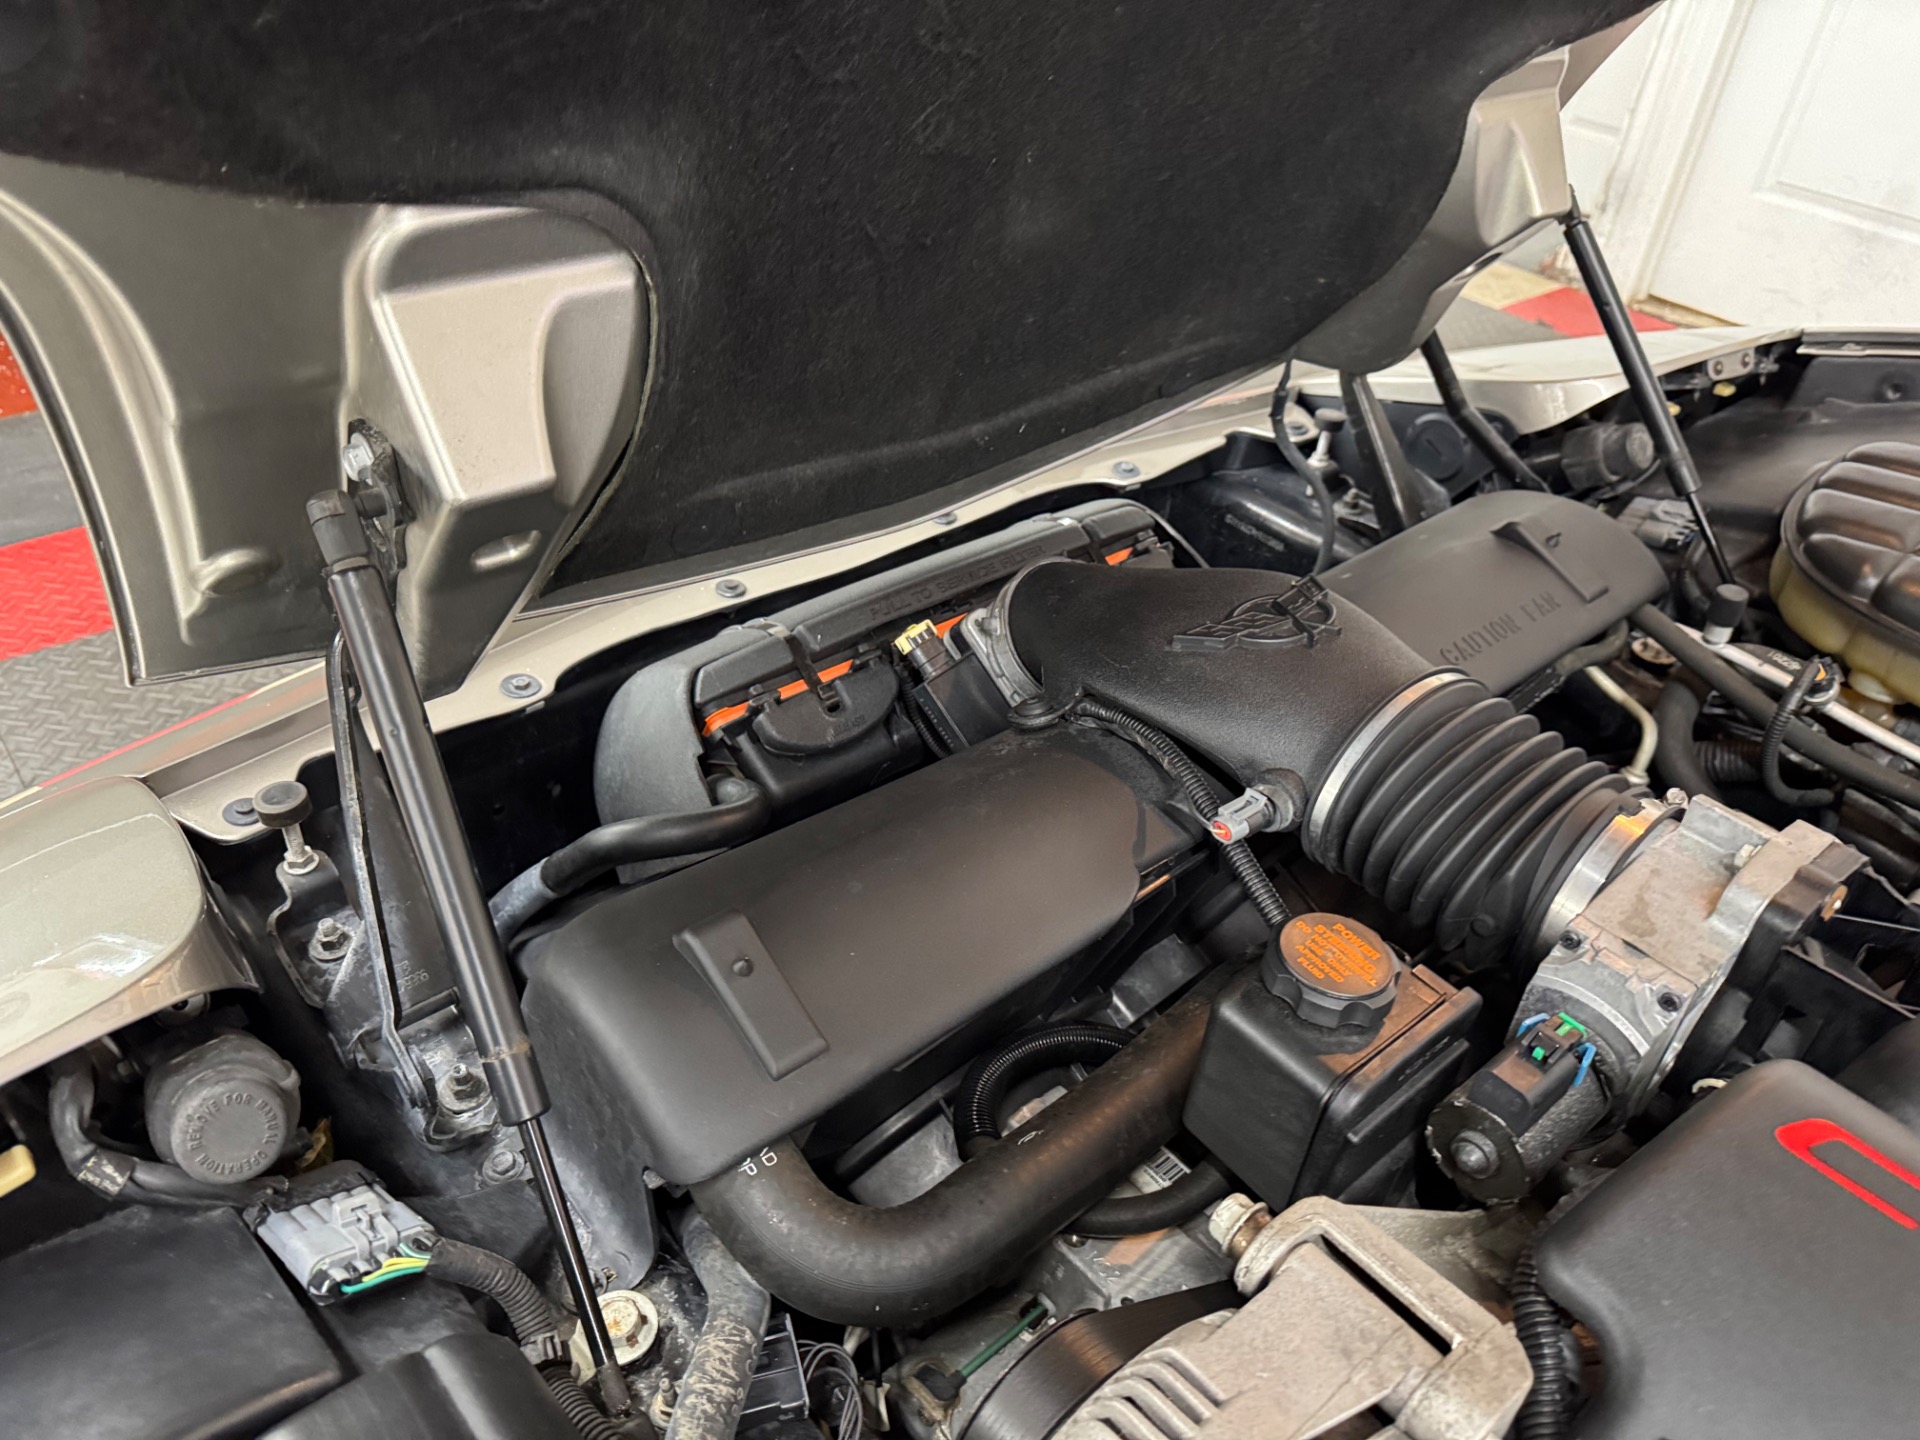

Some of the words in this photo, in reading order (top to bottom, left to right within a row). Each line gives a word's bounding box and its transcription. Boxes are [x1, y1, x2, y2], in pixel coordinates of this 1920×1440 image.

[869, 595, 911, 621] PULL
[911, 586, 932, 602] TO
[935, 562, 1000, 593] SERVICE
[1001, 544, 1046, 570] FILTER
[1439, 613, 1522, 665] CAUTION
[1519, 591, 1561, 622] FAN
[1296, 921, 1312, 933] DO
[1311, 934, 1331, 949] NOT
[1333, 950, 1378, 987] OVERFILL
[1305, 940, 1325, 956] USE
[1327, 957, 1352, 977] ONLY
[1314, 924, 1376, 973] STEERING
[1332, 923, 1381, 960] POWER
[1295, 945, 1344, 983] APPROVED
[1297, 957, 1326, 980] FLUID
[223, 1092, 254, 1106] FOR
[255, 1099, 280, 1144] MANUAL
[195, 1150, 268, 1175] OPERATION
